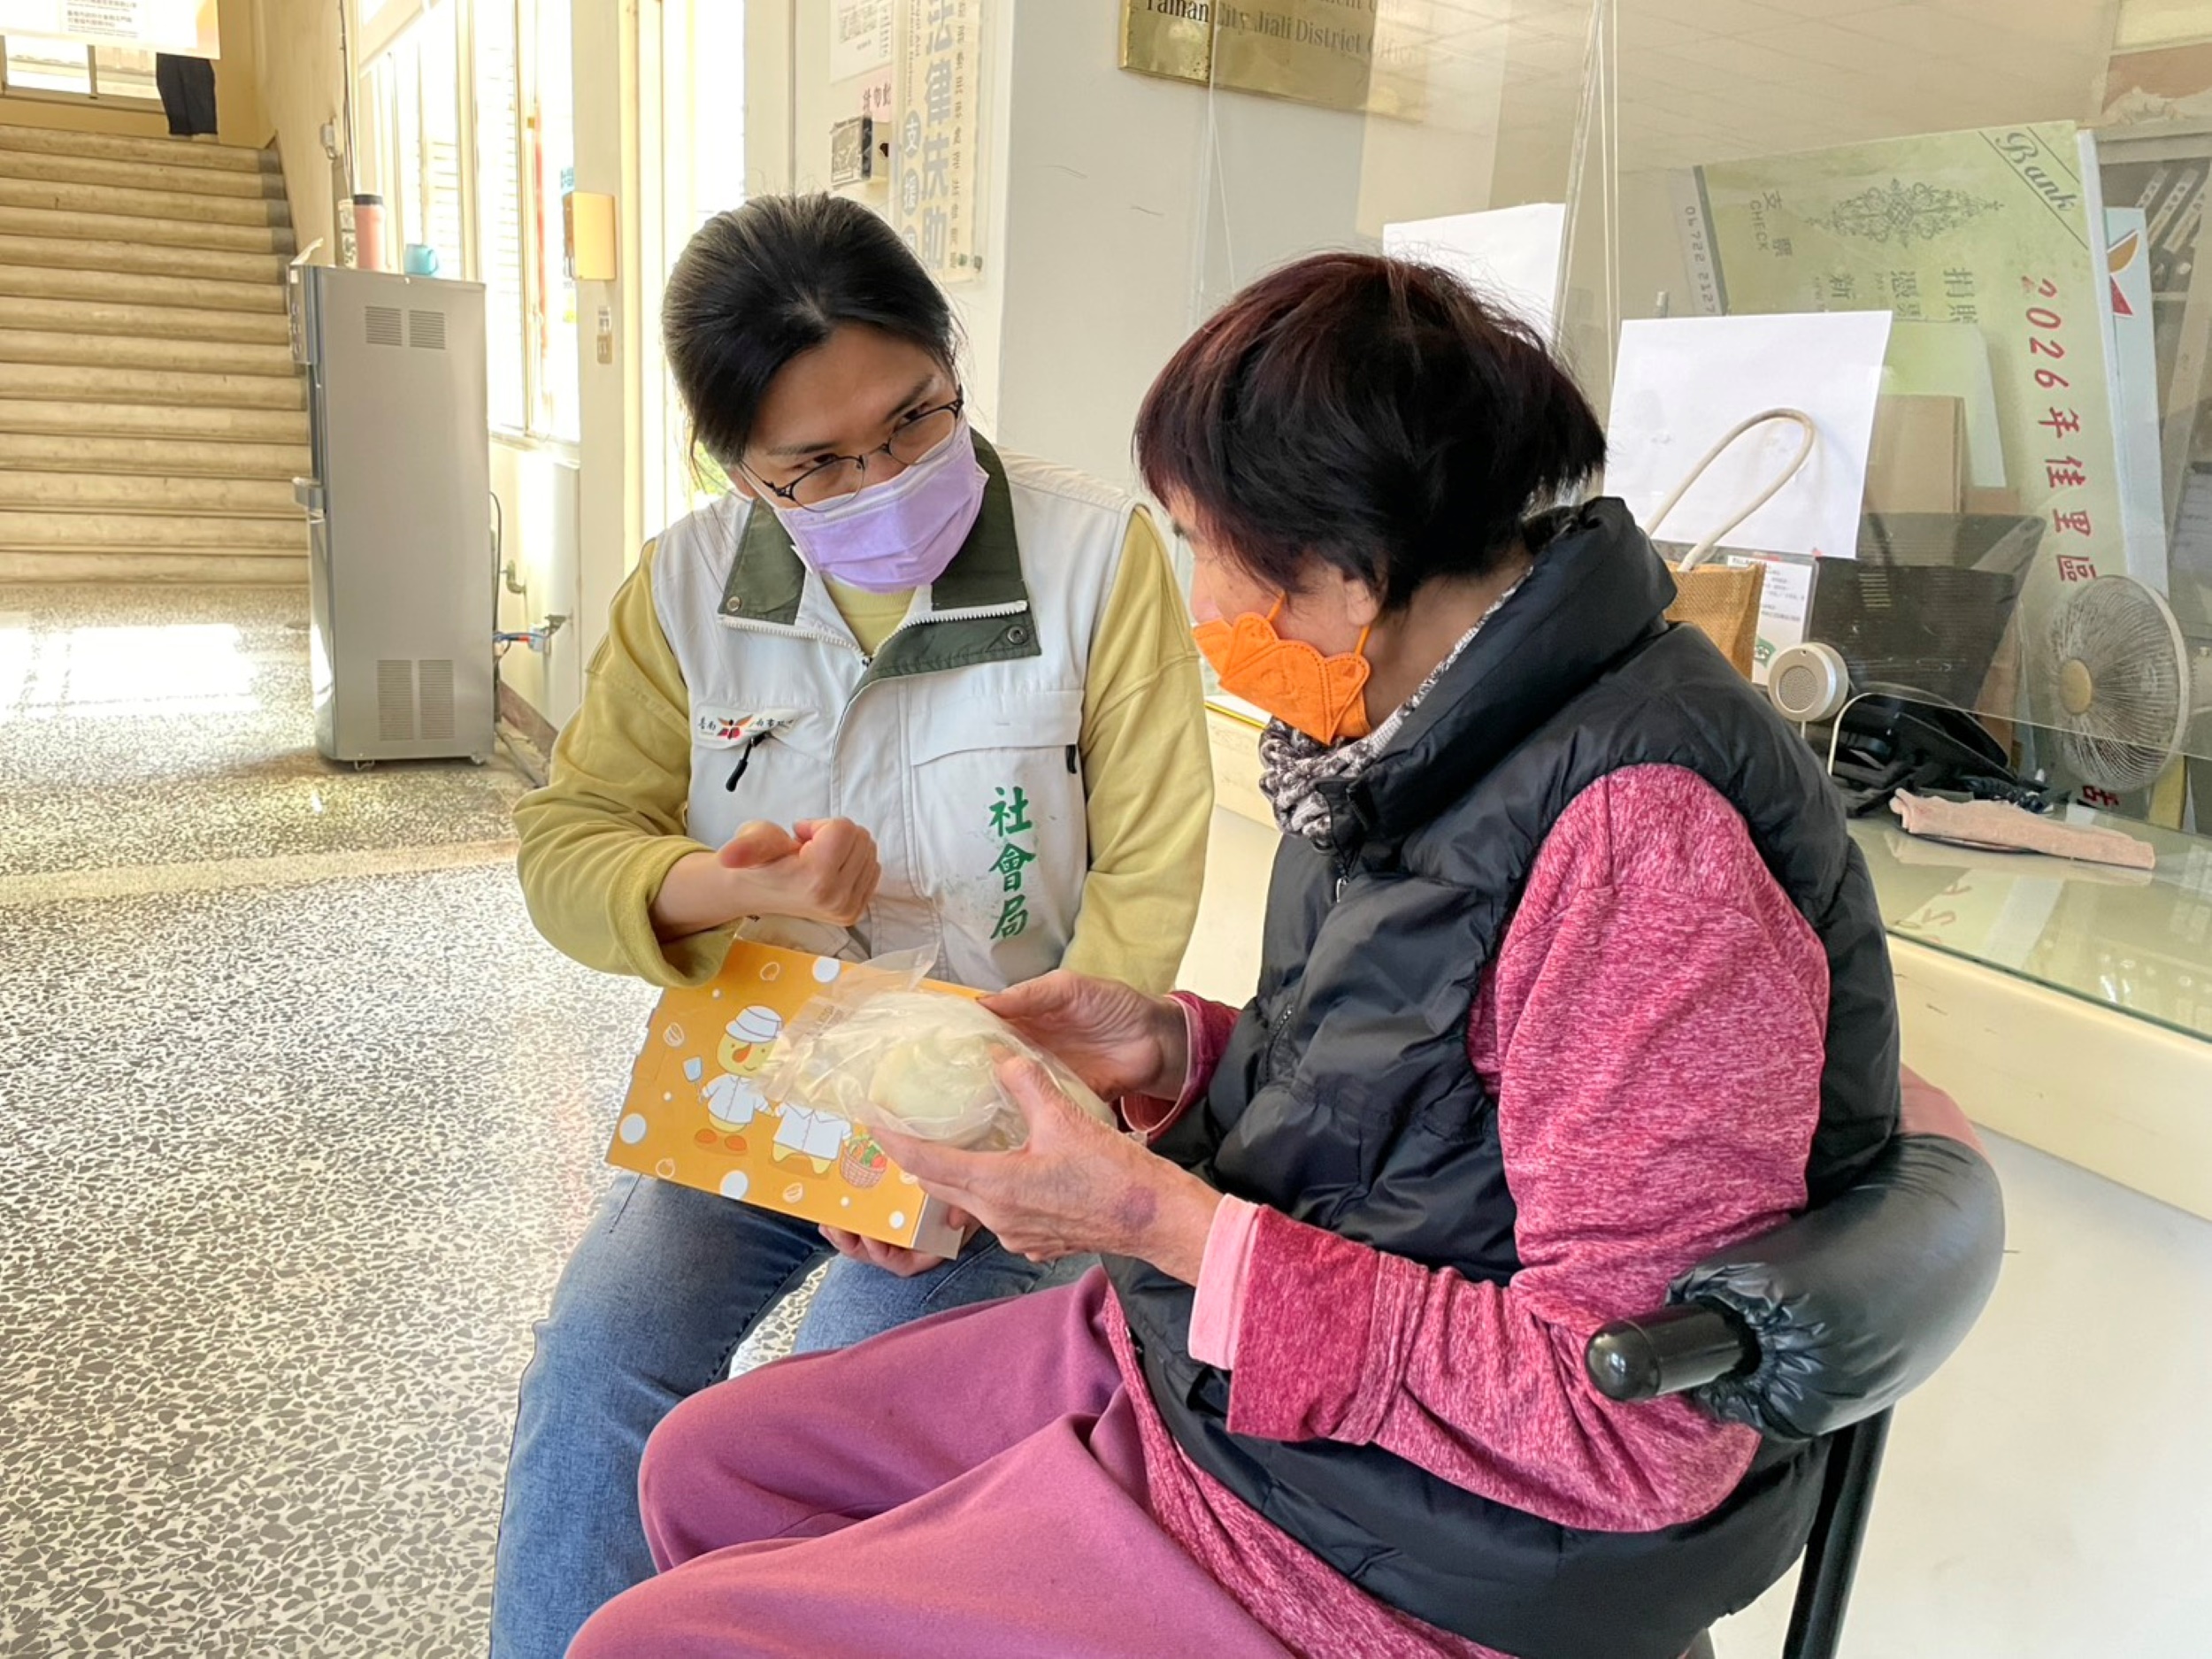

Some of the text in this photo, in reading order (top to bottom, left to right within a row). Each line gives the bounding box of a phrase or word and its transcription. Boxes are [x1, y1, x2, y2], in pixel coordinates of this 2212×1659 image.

[1295, 18, 1361, 54] District
[1994, 132, 2078, 211] Bank
[1749, 199, 1770, 251] CHECK
[988, 787, 1036, 940] 社會局
